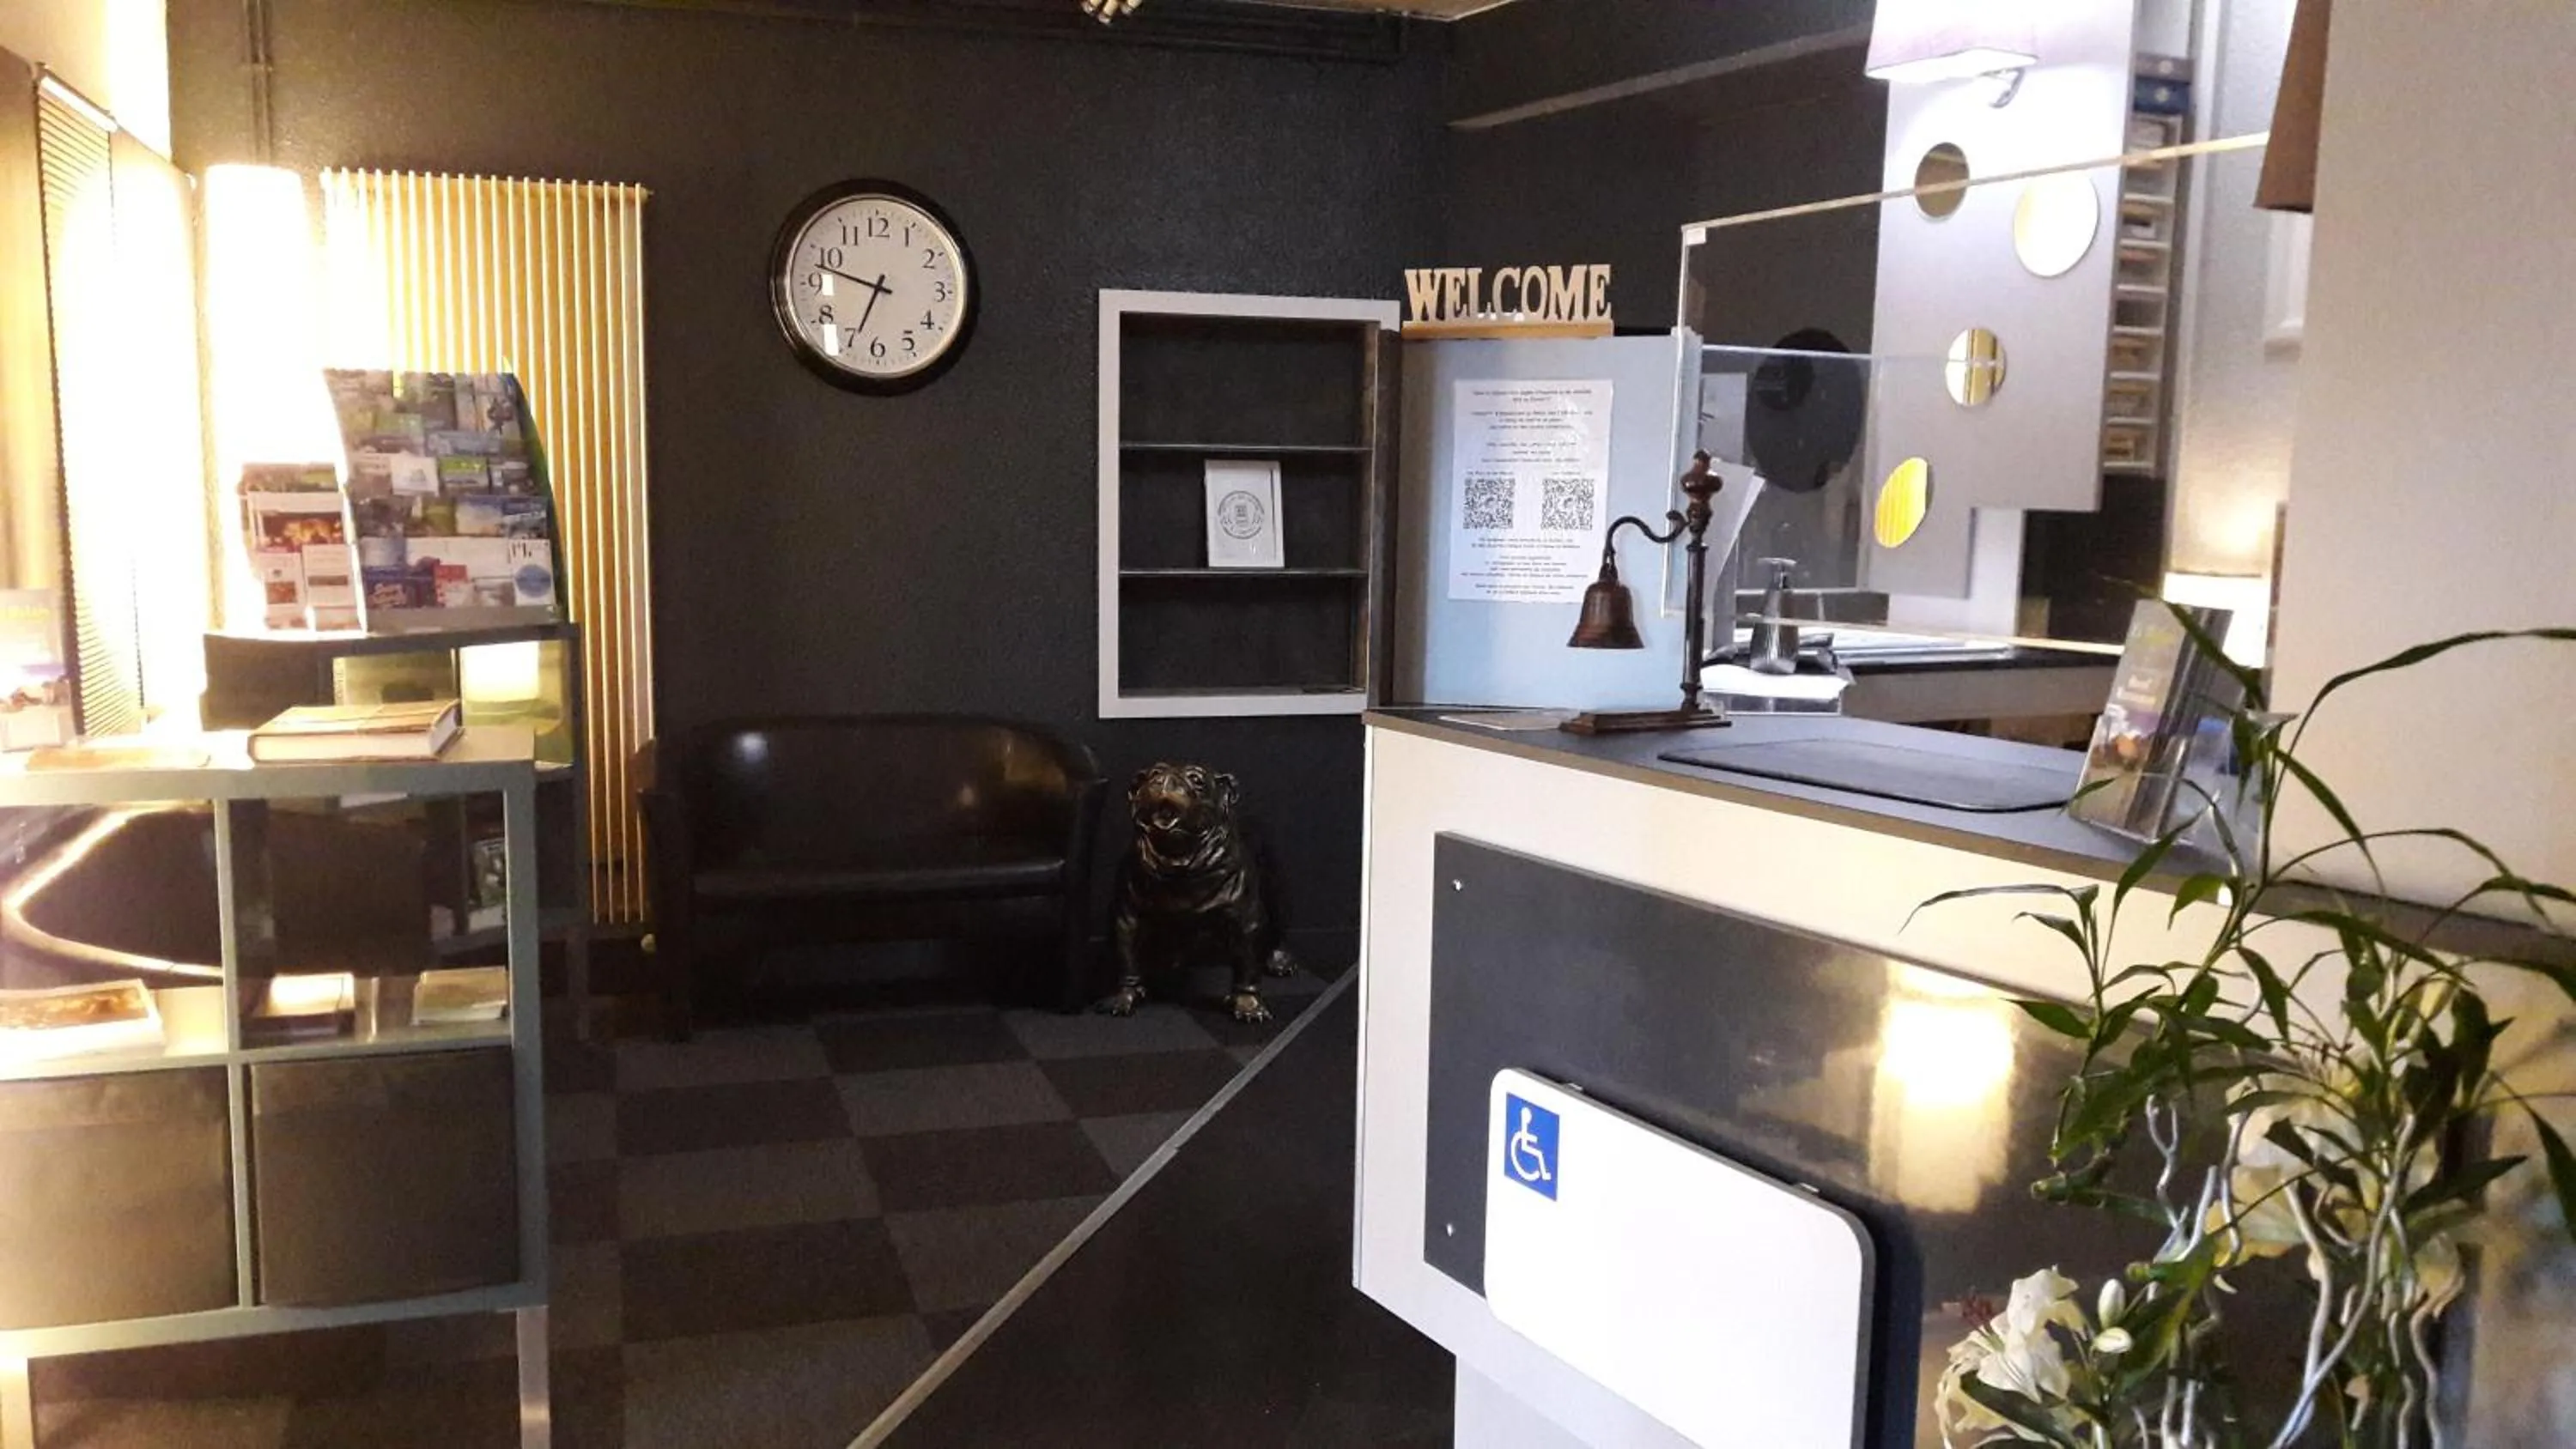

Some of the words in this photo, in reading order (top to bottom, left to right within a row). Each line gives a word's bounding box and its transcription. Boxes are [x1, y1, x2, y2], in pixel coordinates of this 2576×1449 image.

[841, 225, 859, 246] 11
[868, 217, 890, 239] 12
[904, 227, 910, 247] 1
[819, 246, 843, 269] 10
[923, 249, 936, 270] 2
[808, 272, 823, 294] 9
[934, 281, 946, 302] 3
[1404, 264, 1611, 322] WELCOME
[818, 305, 835, 325] 8
[920, 310, 935, 330] 4
[844, 328, 857, 348] 7
[870, 336, 886, 358] 6
[902, 330, 915, 351] 5
